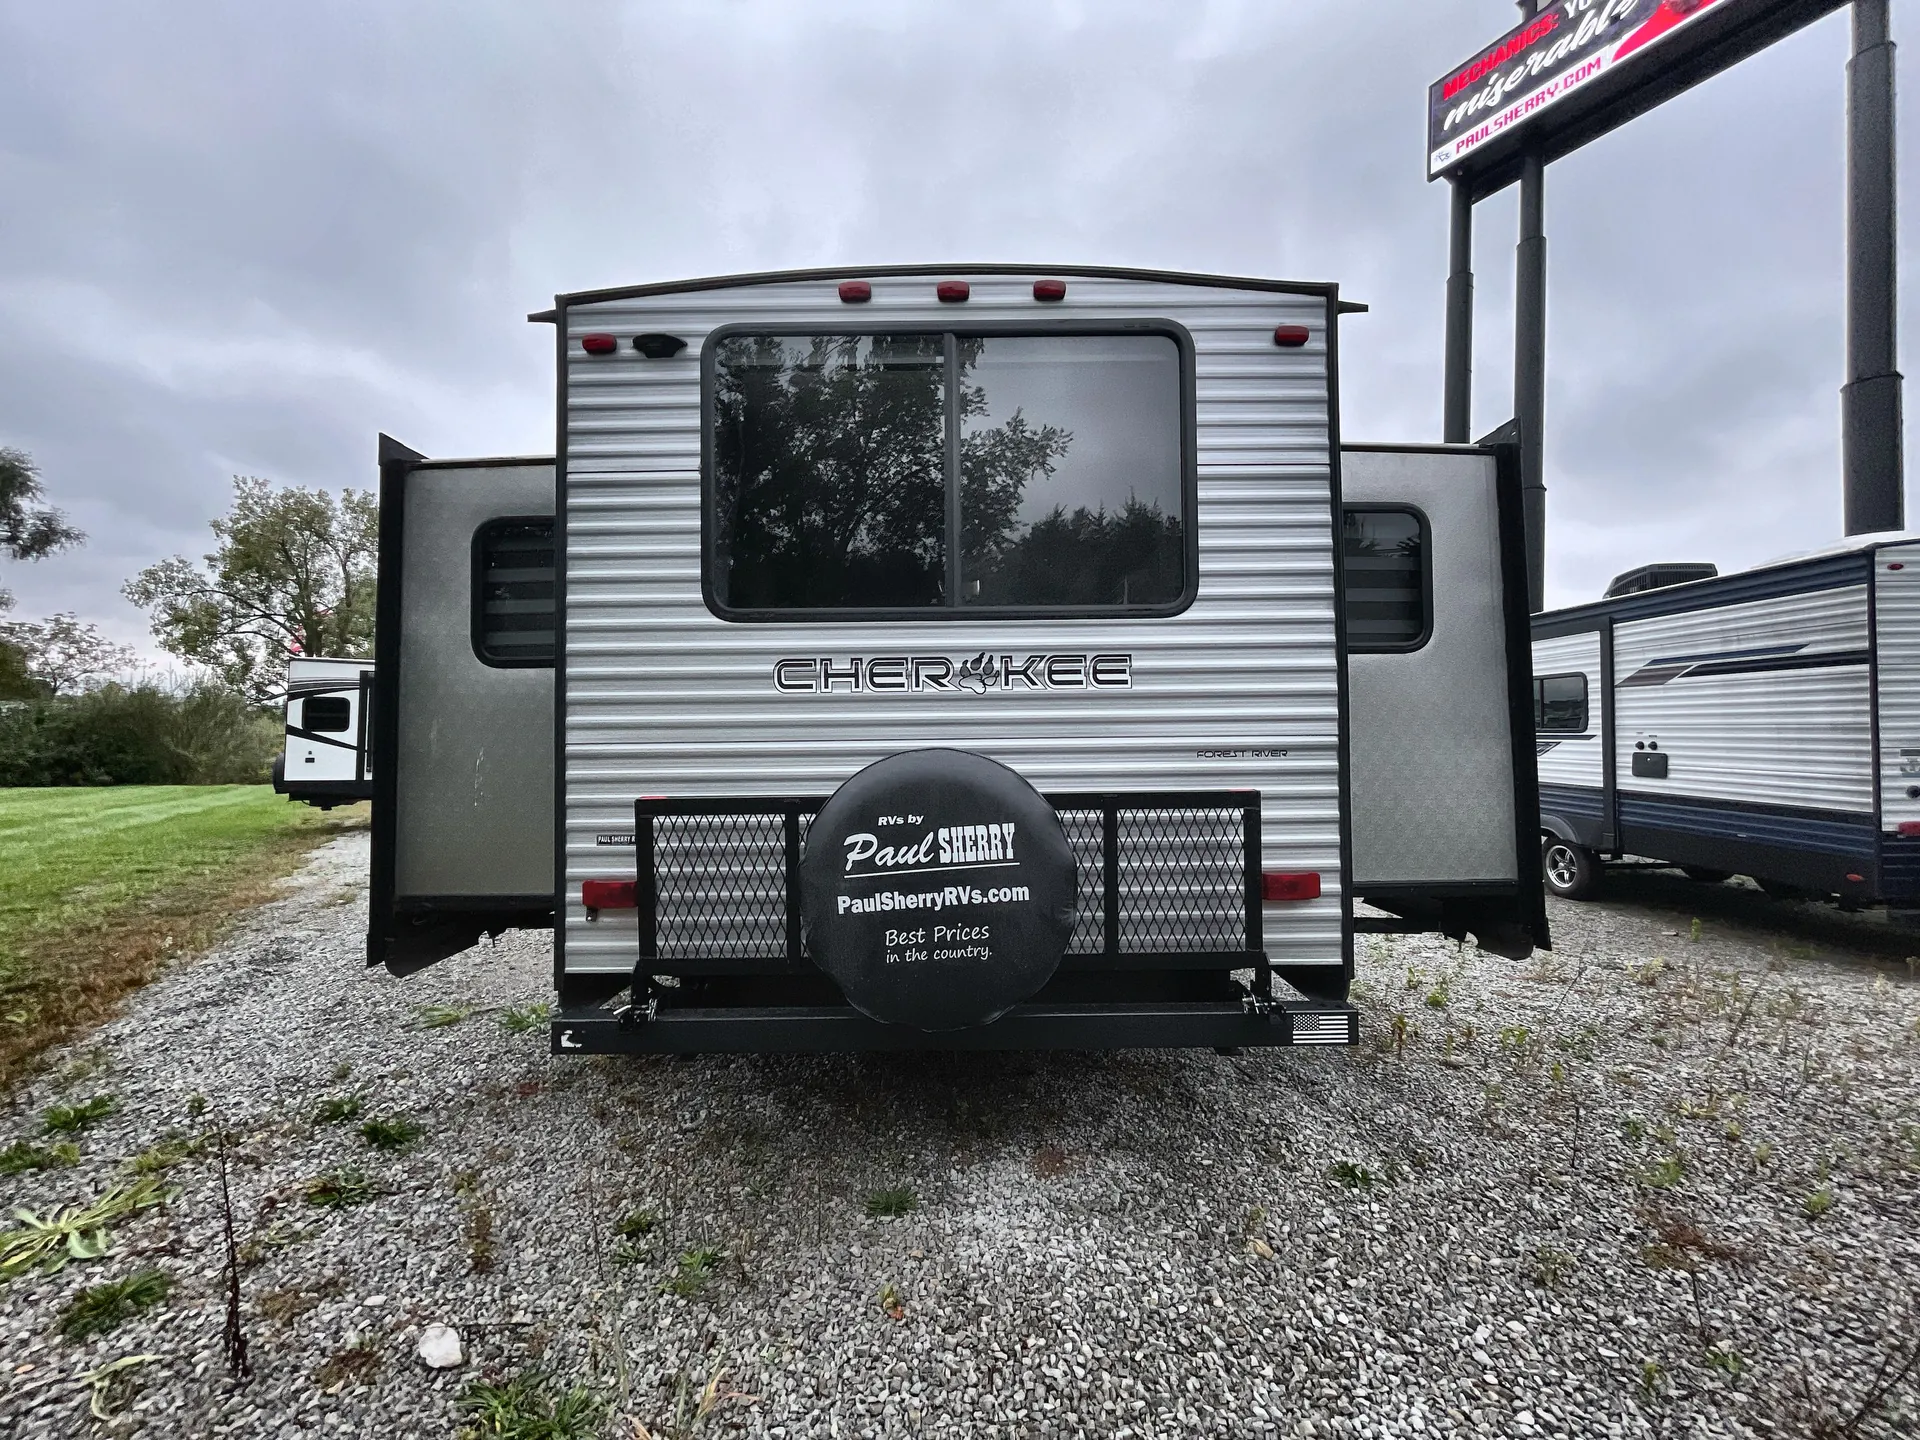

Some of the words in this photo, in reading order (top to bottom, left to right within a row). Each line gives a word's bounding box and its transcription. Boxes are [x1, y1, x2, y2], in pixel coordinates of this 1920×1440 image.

[1442, 13, 1559, 101] MECHANICS:
[1455, 56, 1602, 154] PAULSHERRY.COM
[1196, 750, 1247, 759] FOREST
[1251, 749, 1288, 758] RIVER
[878, 815, 904, 826] RVs
[908, 814, 924, 825] by
[598, 835, 610, 843] PAUL
[611, 835, 630, 843] SHERRY
[843, 831, 934, 871] Paul
[937, 822, 1015, 864] SHERRY
[837, 885, 1030, 914] PaulSherryRVs.com
[885, 927, 926, 946] Best
[933, 923, 990, 943] Prices
[886, 949, 900, 963] in
[904, 947, 928, 961] the
[933, 944, 993, 960] country.
